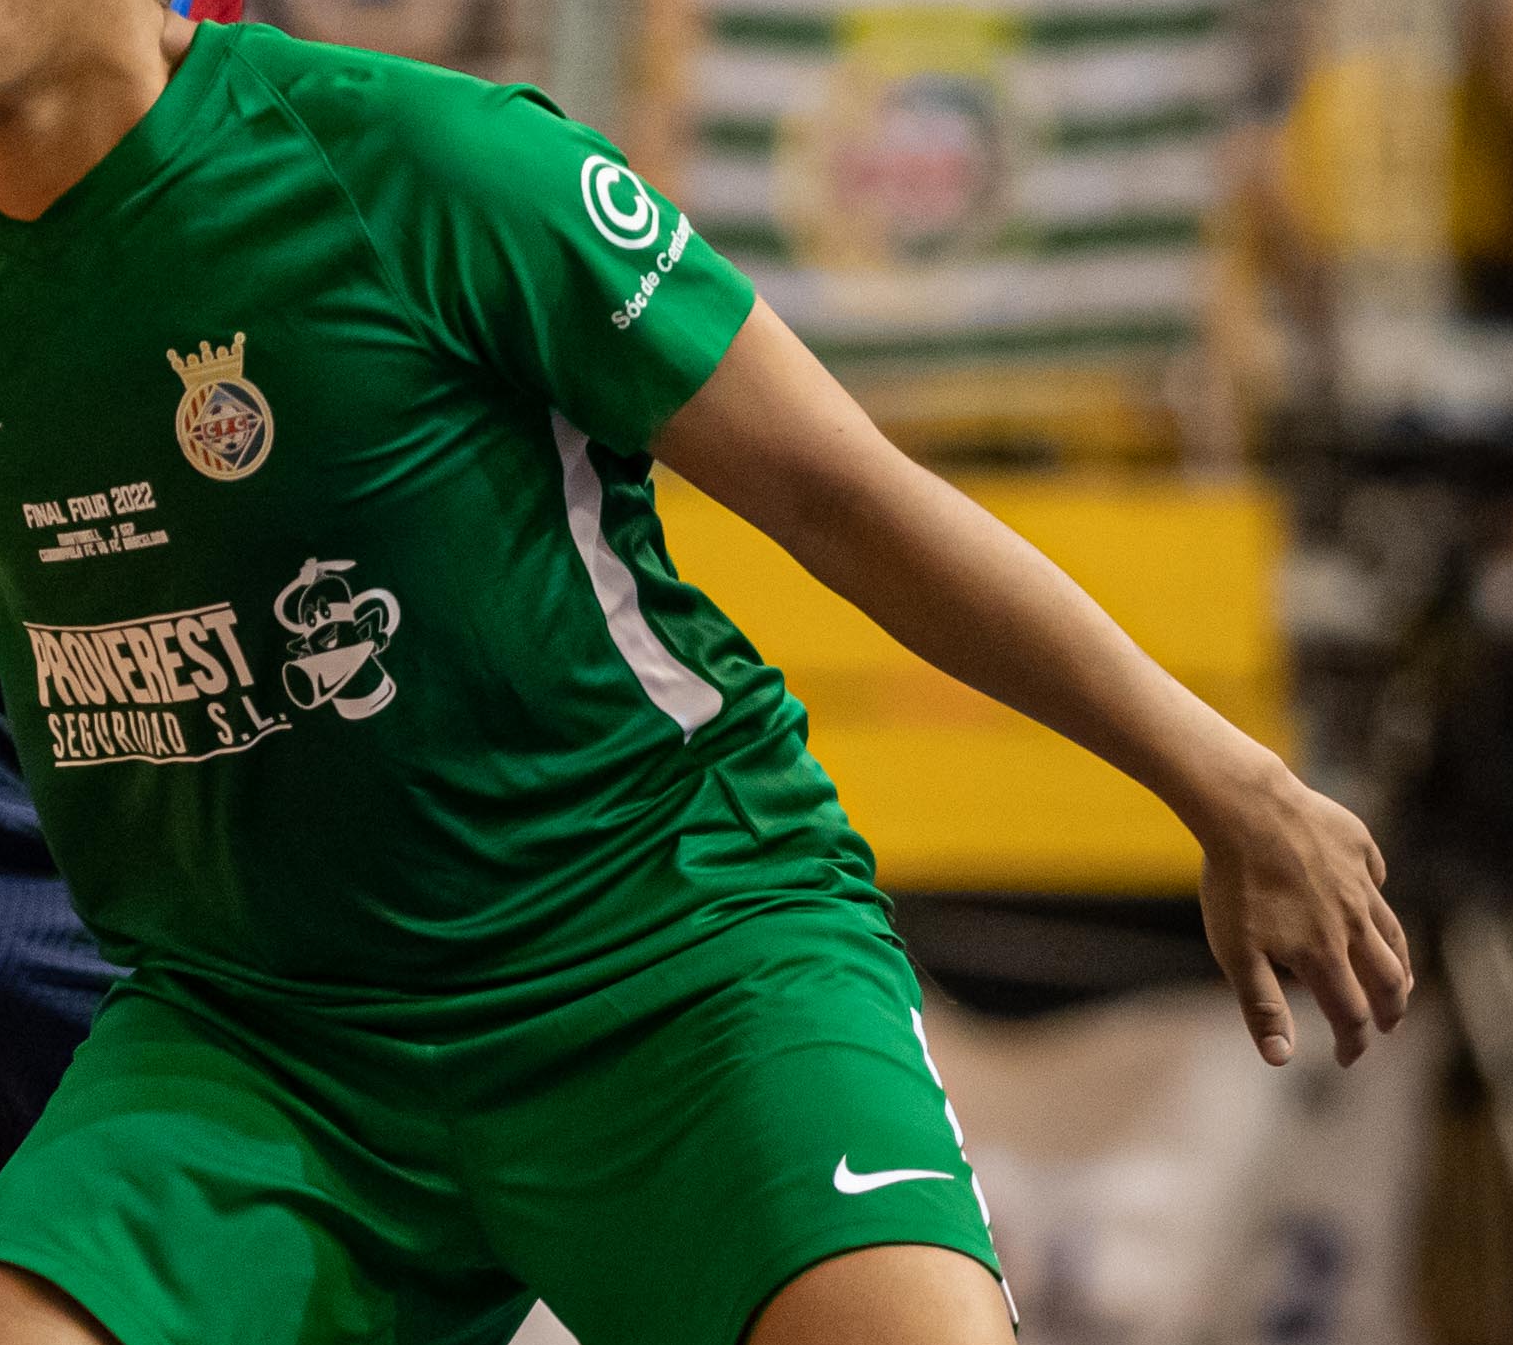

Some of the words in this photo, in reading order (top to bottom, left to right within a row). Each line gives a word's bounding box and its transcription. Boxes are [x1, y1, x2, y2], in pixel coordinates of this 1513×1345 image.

[23, 502, 68, 528] FINAL
[67, 493, 111, 522] FOUR
[110, 482, 156, 515] 2022
[27, 608, 255, 708] PROVEREST
[47, 710, 188, 759] SEGURIDAD
[206, 695, 287, 746] S.L.
